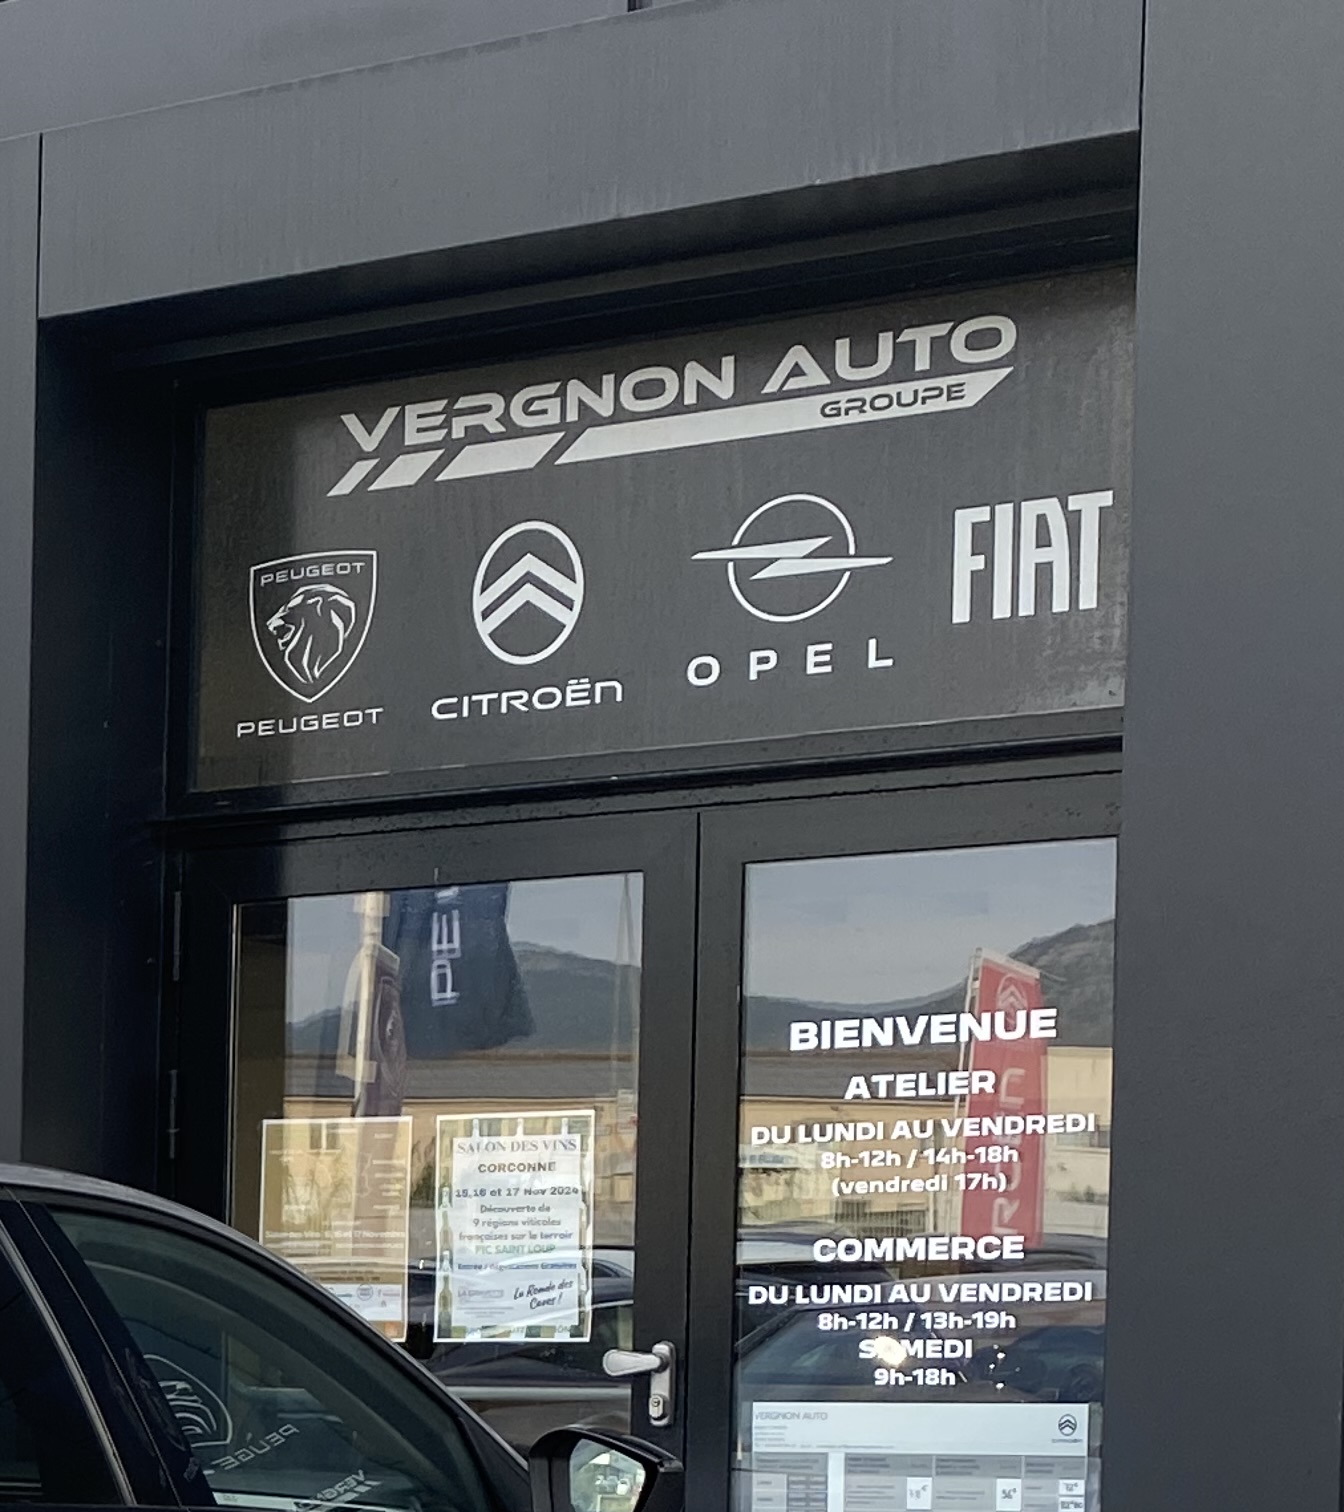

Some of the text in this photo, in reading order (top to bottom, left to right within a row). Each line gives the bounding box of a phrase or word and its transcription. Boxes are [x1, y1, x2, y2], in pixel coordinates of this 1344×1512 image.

[340, 315, 1018, 453] VERGNON AUTO
[818, 381, 968, 419] GROUPE
[951, 490, 1113, 624] FIAT
[259, 560, 366, 587] PEUGEOT
[686, 637, 894, 687] OPEL
[236, 706, 384, 739] PEUGEOT
[789, 1008, 1058, 1051] BIENVENUE
[844, 1070, 996, 1100] ATELIER
[751, 1113, 1095, 1145] DU LUNDI AU VENDREDI
[820, 1149, 901, 1169] 8h-12h
[923, 1146, 1018, 1166] 14h-18h
[831, 1172, 1007, 1197] (vendredi 17h)
[812, 1235, 1025, 1262] COMMERCE
[748, 1281, 1093, 1305] DU LUNDI AU VENDREDI
[817, 1312, 899, 1331] 8h-12h
[920, 1311, 1016, 1330] 13h-19h
[858, 1339, 973, 1360] SMEDI
[873, 1368, 956, 1386] 9h-18h
